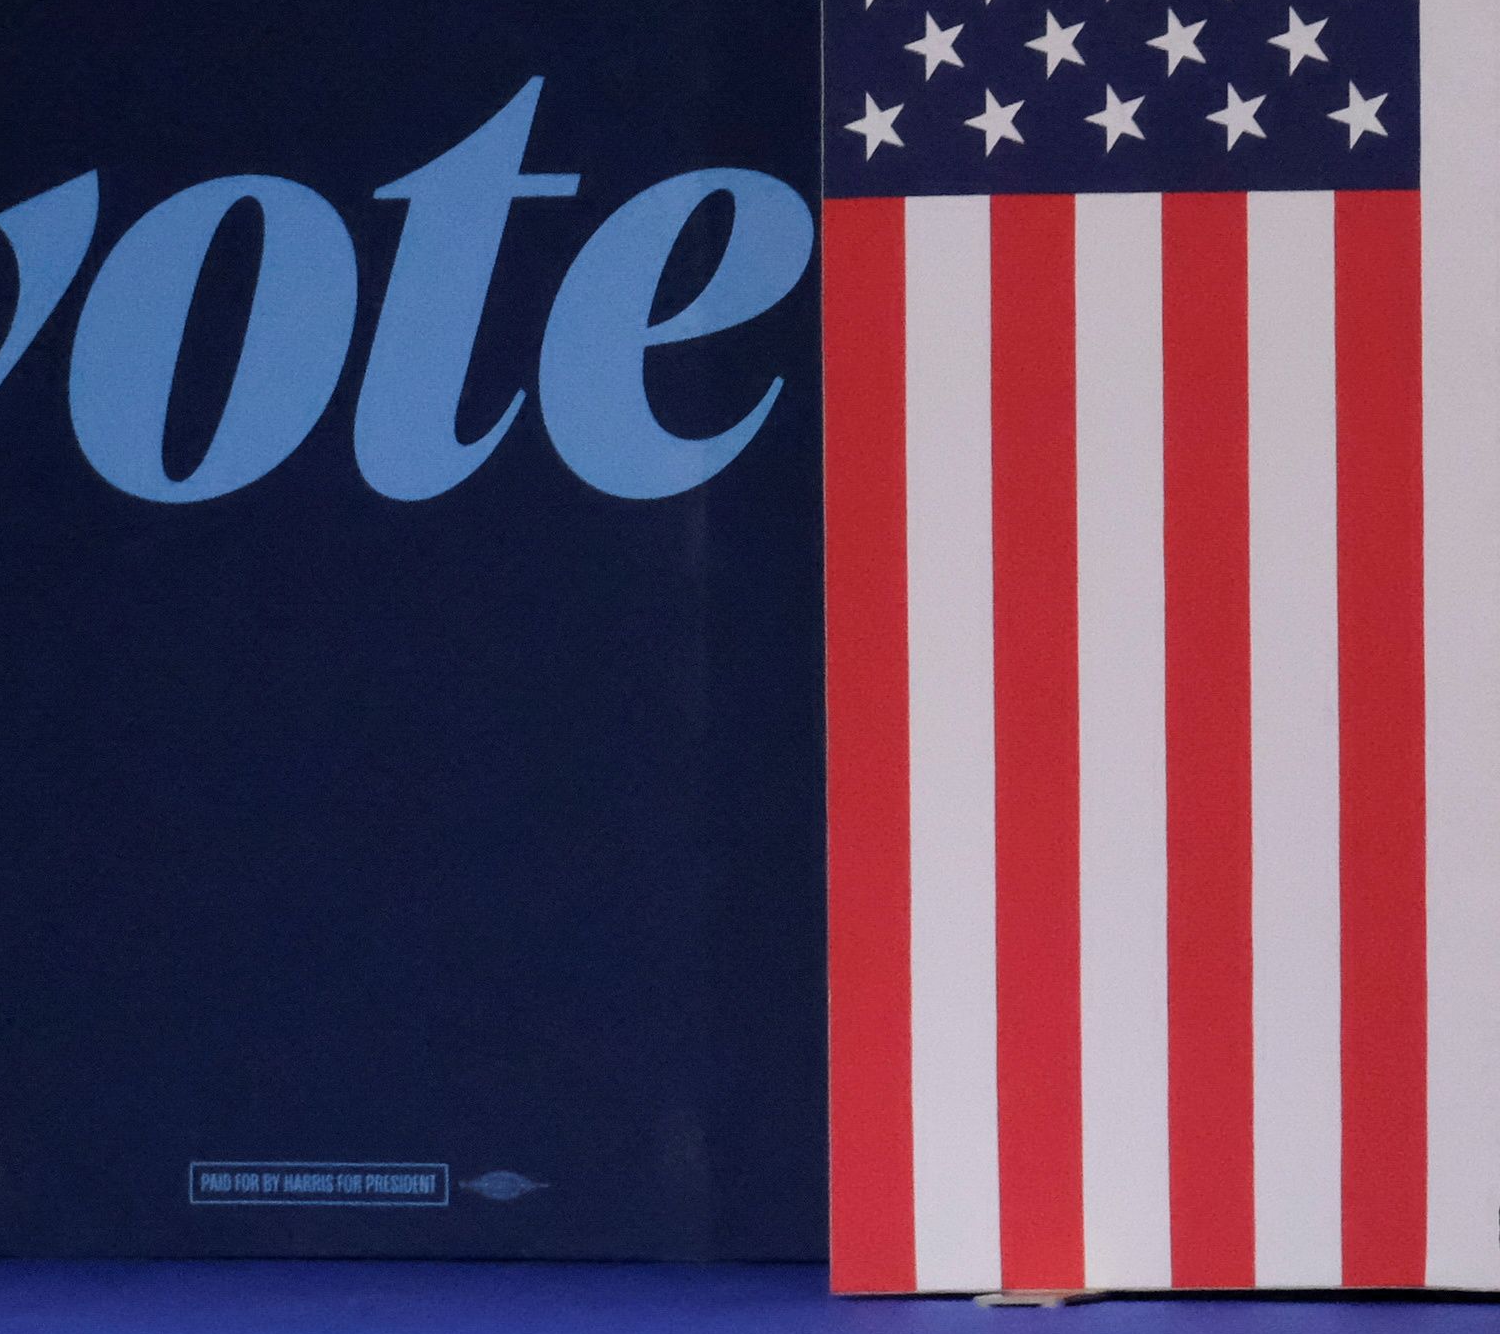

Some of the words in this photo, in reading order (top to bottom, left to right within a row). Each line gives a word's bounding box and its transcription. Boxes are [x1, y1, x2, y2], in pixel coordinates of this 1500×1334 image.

[201, 1173, 231, 1192] PAID
[235, 1173, 260, 1192] FOR
[262, 1173, 280, 1192] BY
[284, 1173, 333, 1193] HARRIS
[338, 1174, 362, 1193] FOR
[366, 1174, 436, 1194] PRESIDENT
